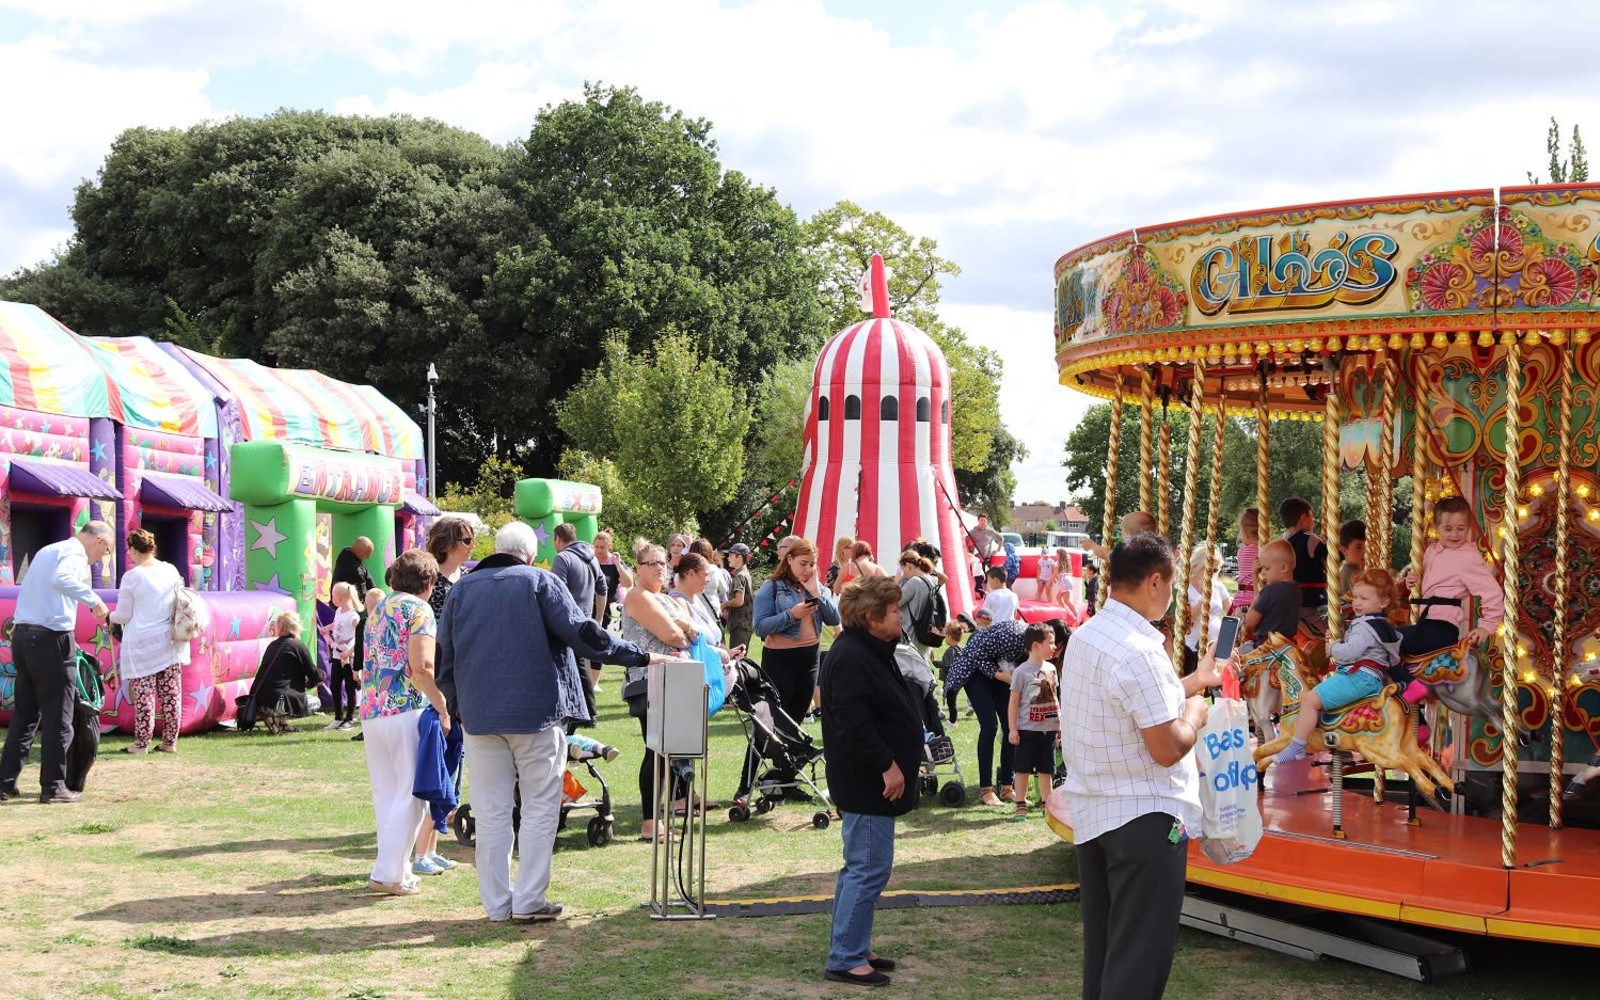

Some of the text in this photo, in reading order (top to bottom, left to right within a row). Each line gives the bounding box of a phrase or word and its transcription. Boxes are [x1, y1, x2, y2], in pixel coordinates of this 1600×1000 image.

[295, 462, 401, 503] ENTRANCE
[562, 491, 599, 511] EXIT
[1030, 712, 1046, 721] REX
